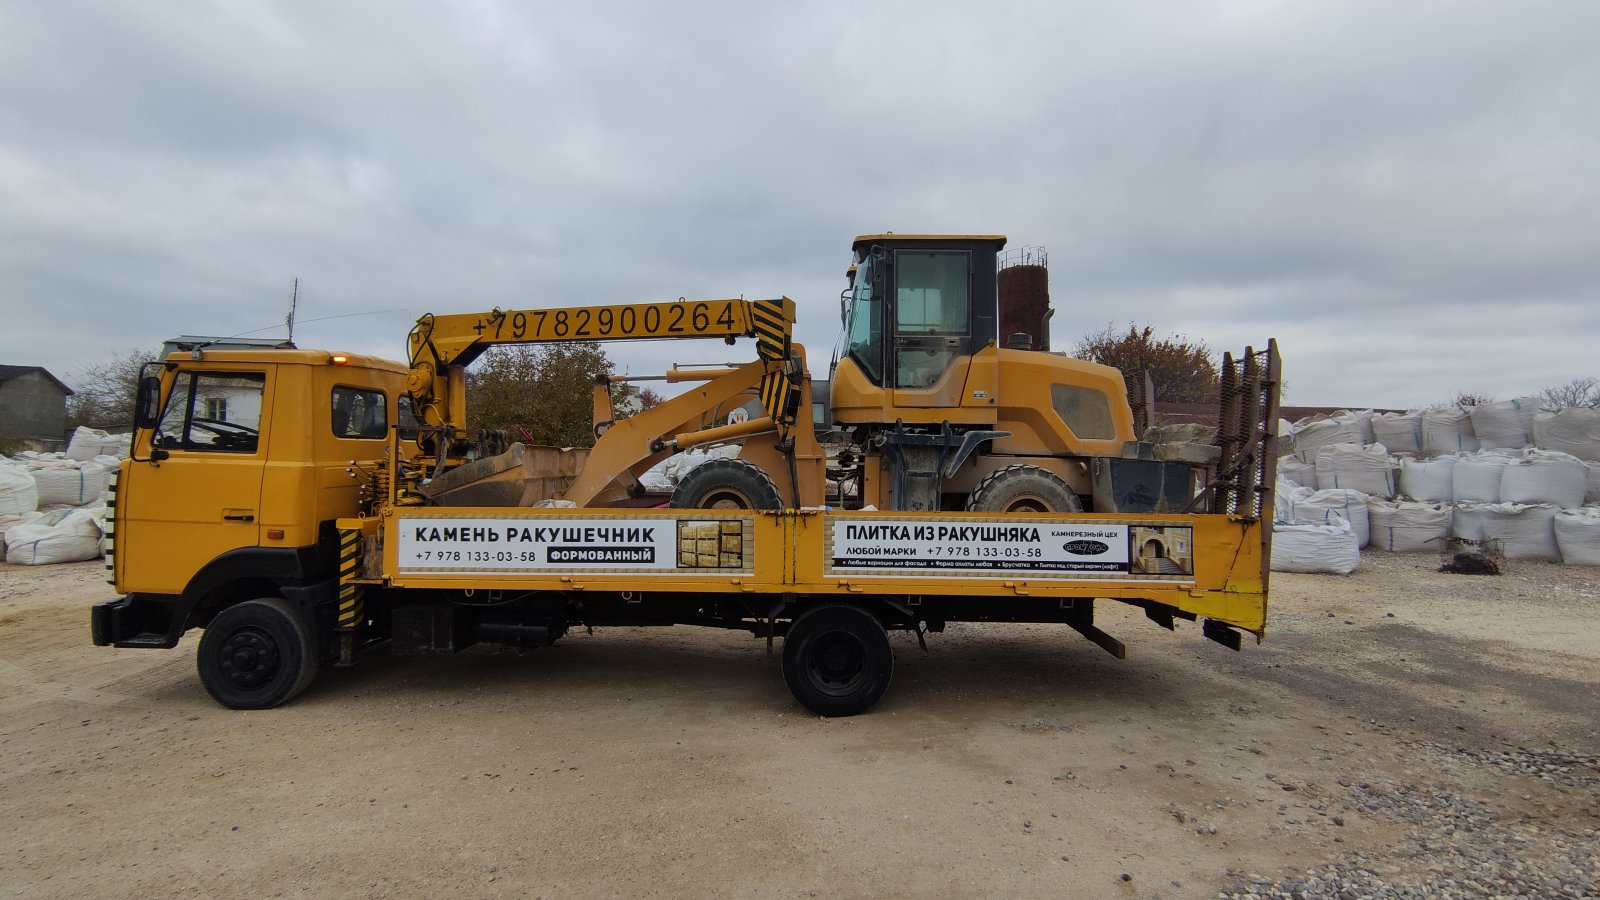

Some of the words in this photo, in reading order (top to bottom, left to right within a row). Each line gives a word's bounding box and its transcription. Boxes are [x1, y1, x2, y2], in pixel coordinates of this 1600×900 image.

[415, 528, 500, 543] КАМЕНЬ
[506, 528, 655, 543] РАКУШЕЧНИК
[846, 525, 911, 540] ПЛИТКА
[914, 526, 935, 541] ИЗ
[939, 527, 1041, 542] РАКУШНЯКА
[415, 551, 432, 562] +7
[437, 551, 461, 562] 978
[466, 552, 536, 562] 133-03-58
[550, 548, 652, 562] ФОРМОВАННЫЙ
[846, 546, 882, 555] ЛЮБОЙ
[883, 547, 917, 556] МАРКИ
[927, 547, 942, 556] +7
[947, 547, 970, 556] 978
[976, 547, 1042, 557] 133-03-58
